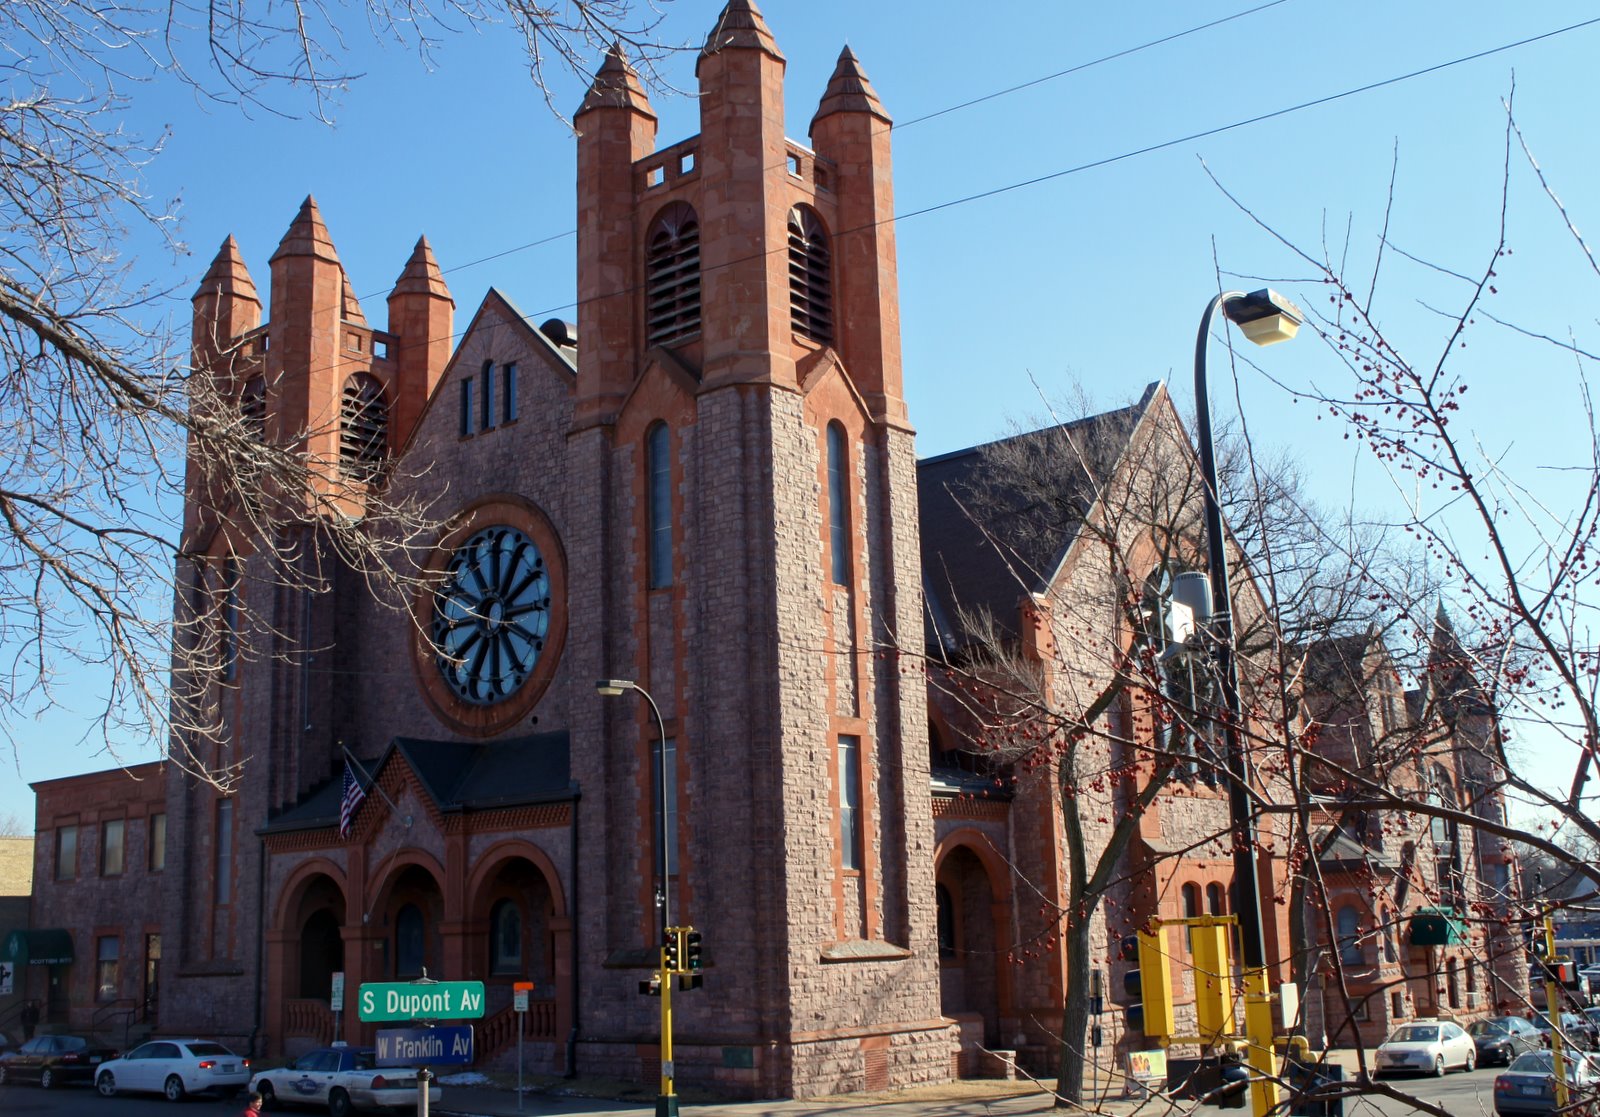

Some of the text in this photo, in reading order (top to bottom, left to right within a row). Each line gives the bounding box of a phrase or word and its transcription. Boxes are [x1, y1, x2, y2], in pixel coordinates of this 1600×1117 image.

[363, 991, 375, 1014] S
[387, 989, 450, 1016] Dupont
[460, 989, 481, 1011] Av
[378, 1033, 470, 1059] W Franklin Av
